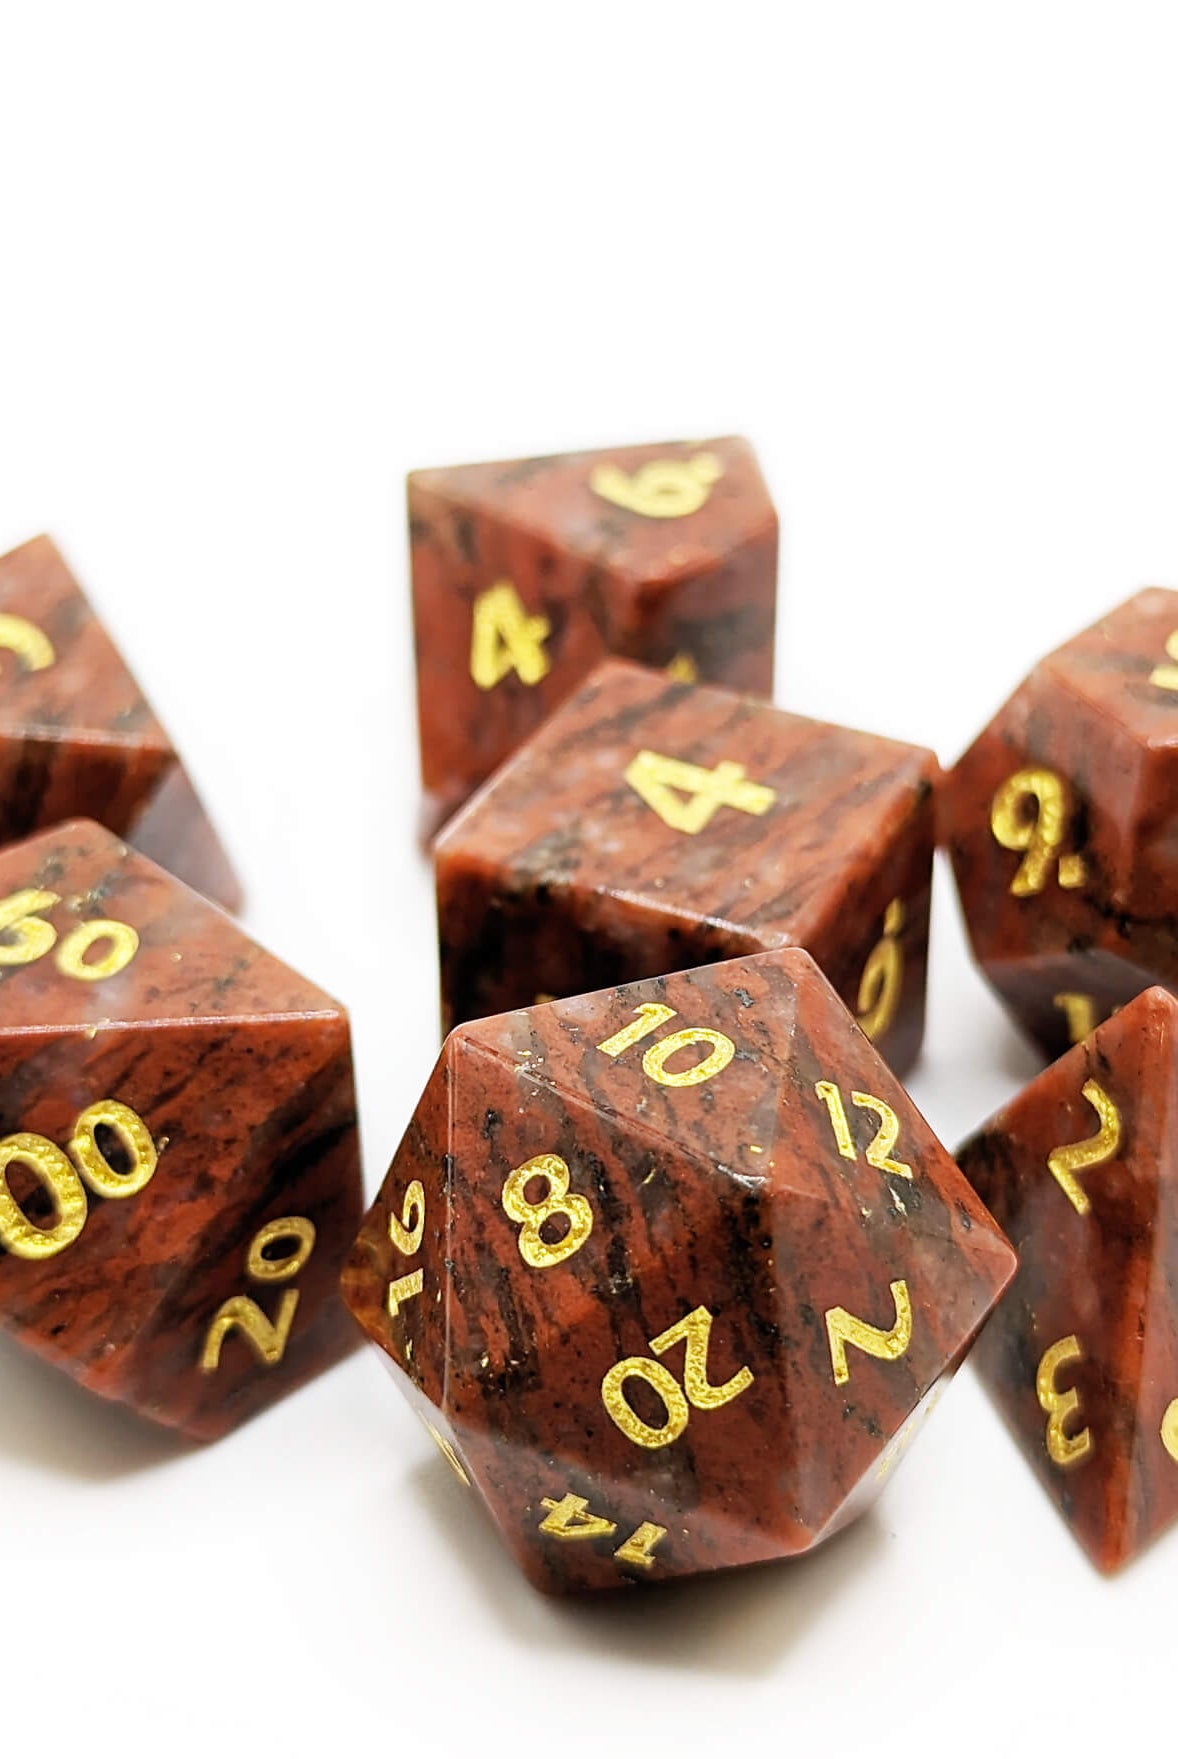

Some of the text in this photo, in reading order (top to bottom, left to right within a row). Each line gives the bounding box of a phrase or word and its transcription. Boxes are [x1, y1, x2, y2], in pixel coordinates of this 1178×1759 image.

[471, 582, 550, 690] 4
[624, 749, 778, 835] 4
[597, 1001, 737, 1088] 10
[0, 1099, 158, 1260] 00
[815, 1079, 914, 1180] 12
[1046, 1078, 1121, 1214] 2
[388, 1179, 426, 1318] 16
[501, 1153, 594, 1269] 8
[202, 1215, 316, 1371] 20
[825, 1278, 914, 1386] 2
[599, 1304, 755, 1450] 20
[1036, 1334, 1091, 1465] 3
[538, 1491, 668, 1568] 14
